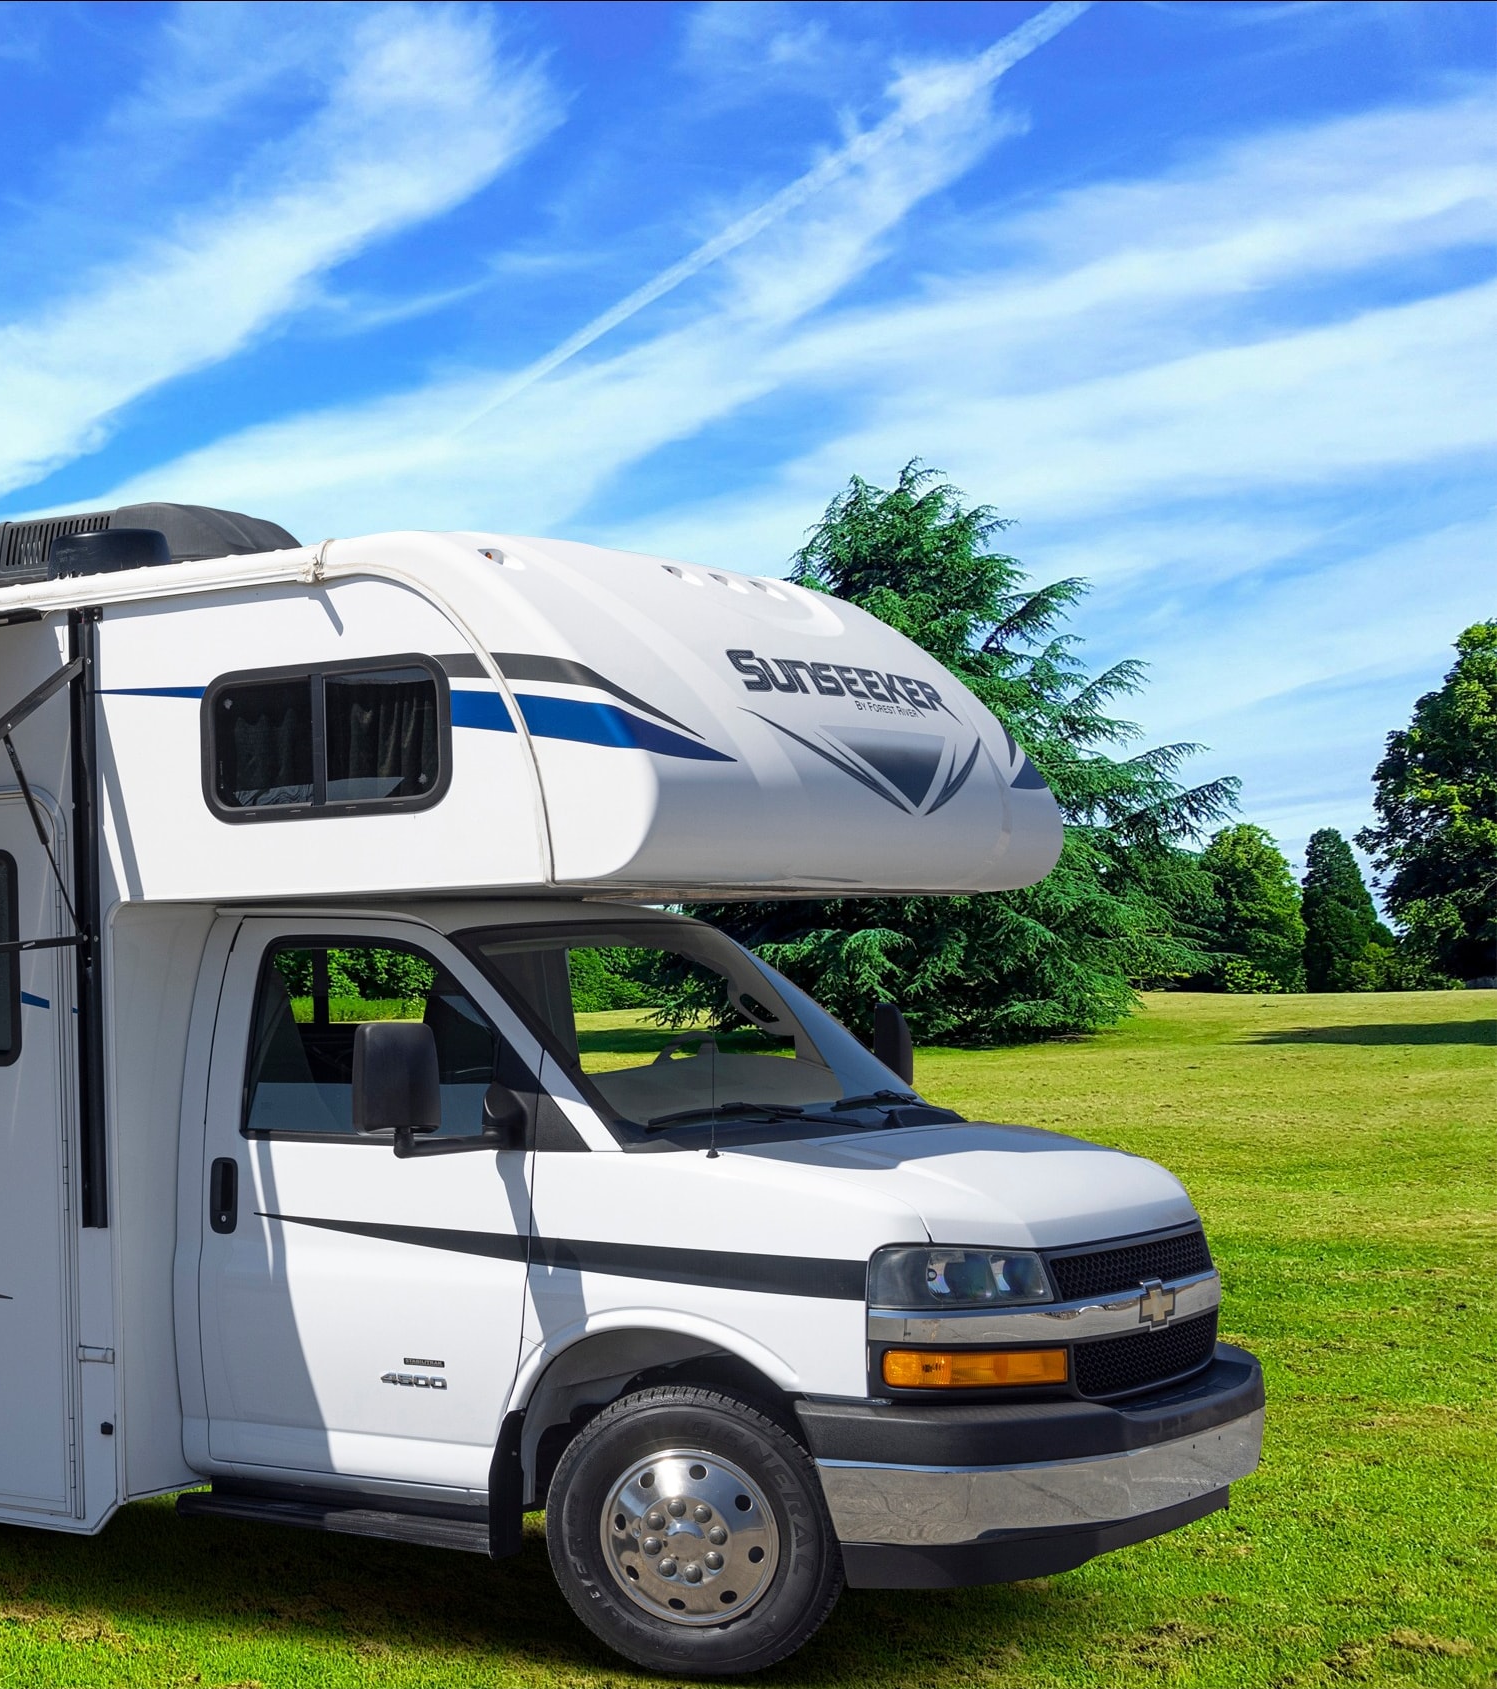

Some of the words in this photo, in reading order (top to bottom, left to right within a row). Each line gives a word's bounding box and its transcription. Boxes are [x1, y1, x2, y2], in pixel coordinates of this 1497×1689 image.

[725, 649, 963, 726] SUNSEEKER
[867, 702, 896, 716] FOREST
[381, 1372, 447, 1390] 4500
